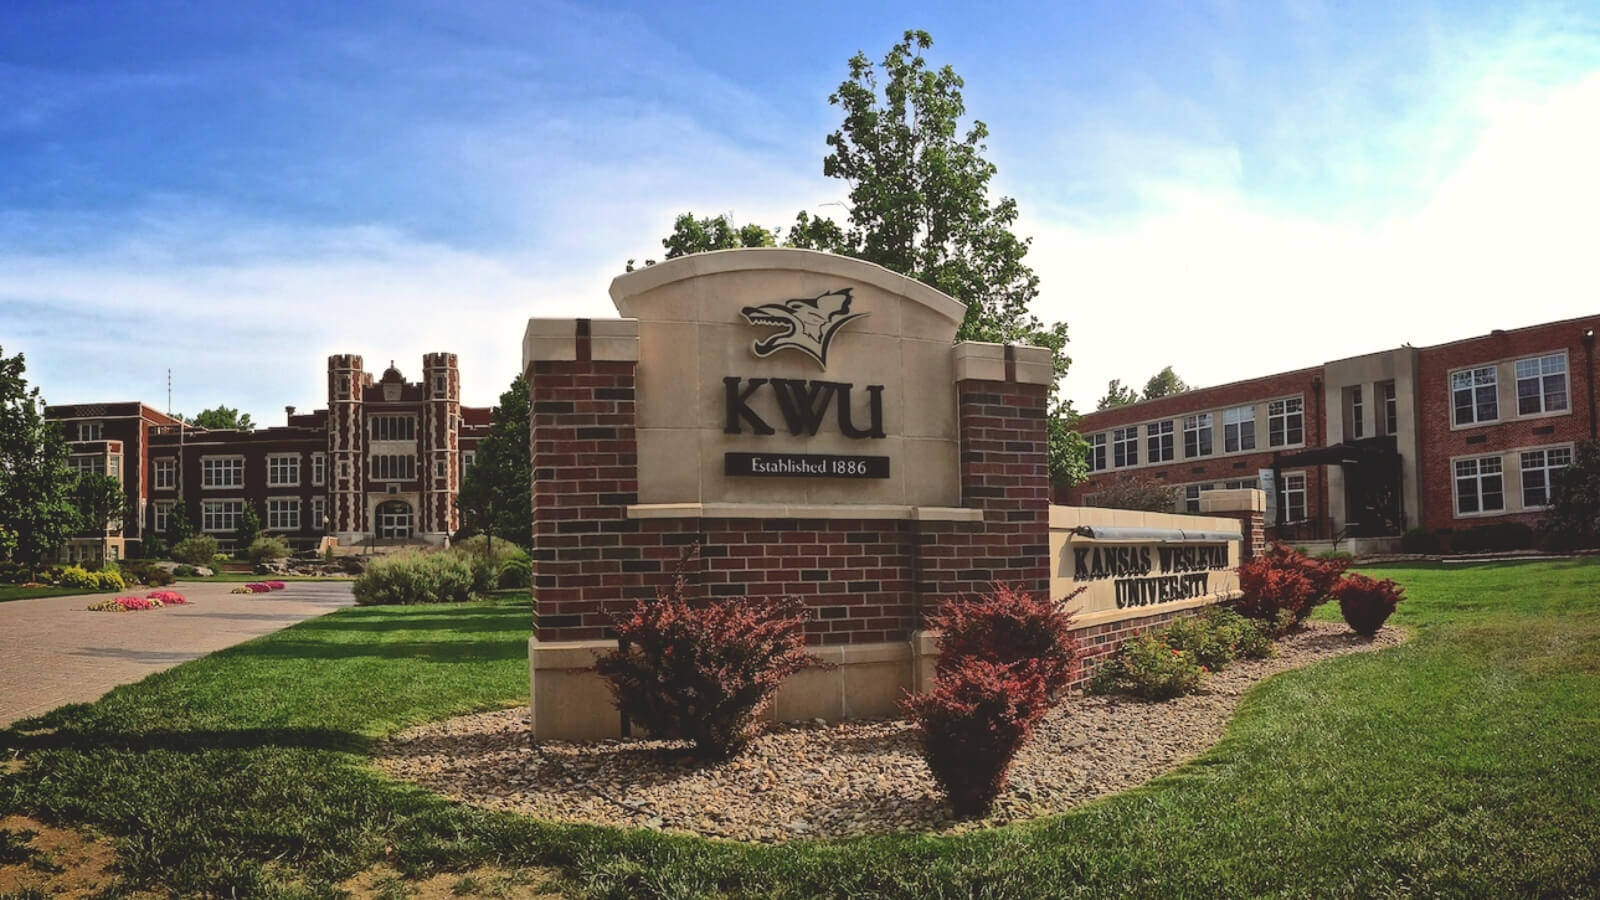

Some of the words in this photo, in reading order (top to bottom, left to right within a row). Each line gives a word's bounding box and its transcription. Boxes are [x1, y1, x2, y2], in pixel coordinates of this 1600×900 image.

[723, 376, 887, 439] KWU
[751, 457, 827, 474] Established
[832, 460, 867, 475] 1886
[1073, 547, 1151, 580] KANSAS
[1157, 545, 1229, 574] WESLEYAN
[1115, 573, 1208, 608] UNIVERSITY
